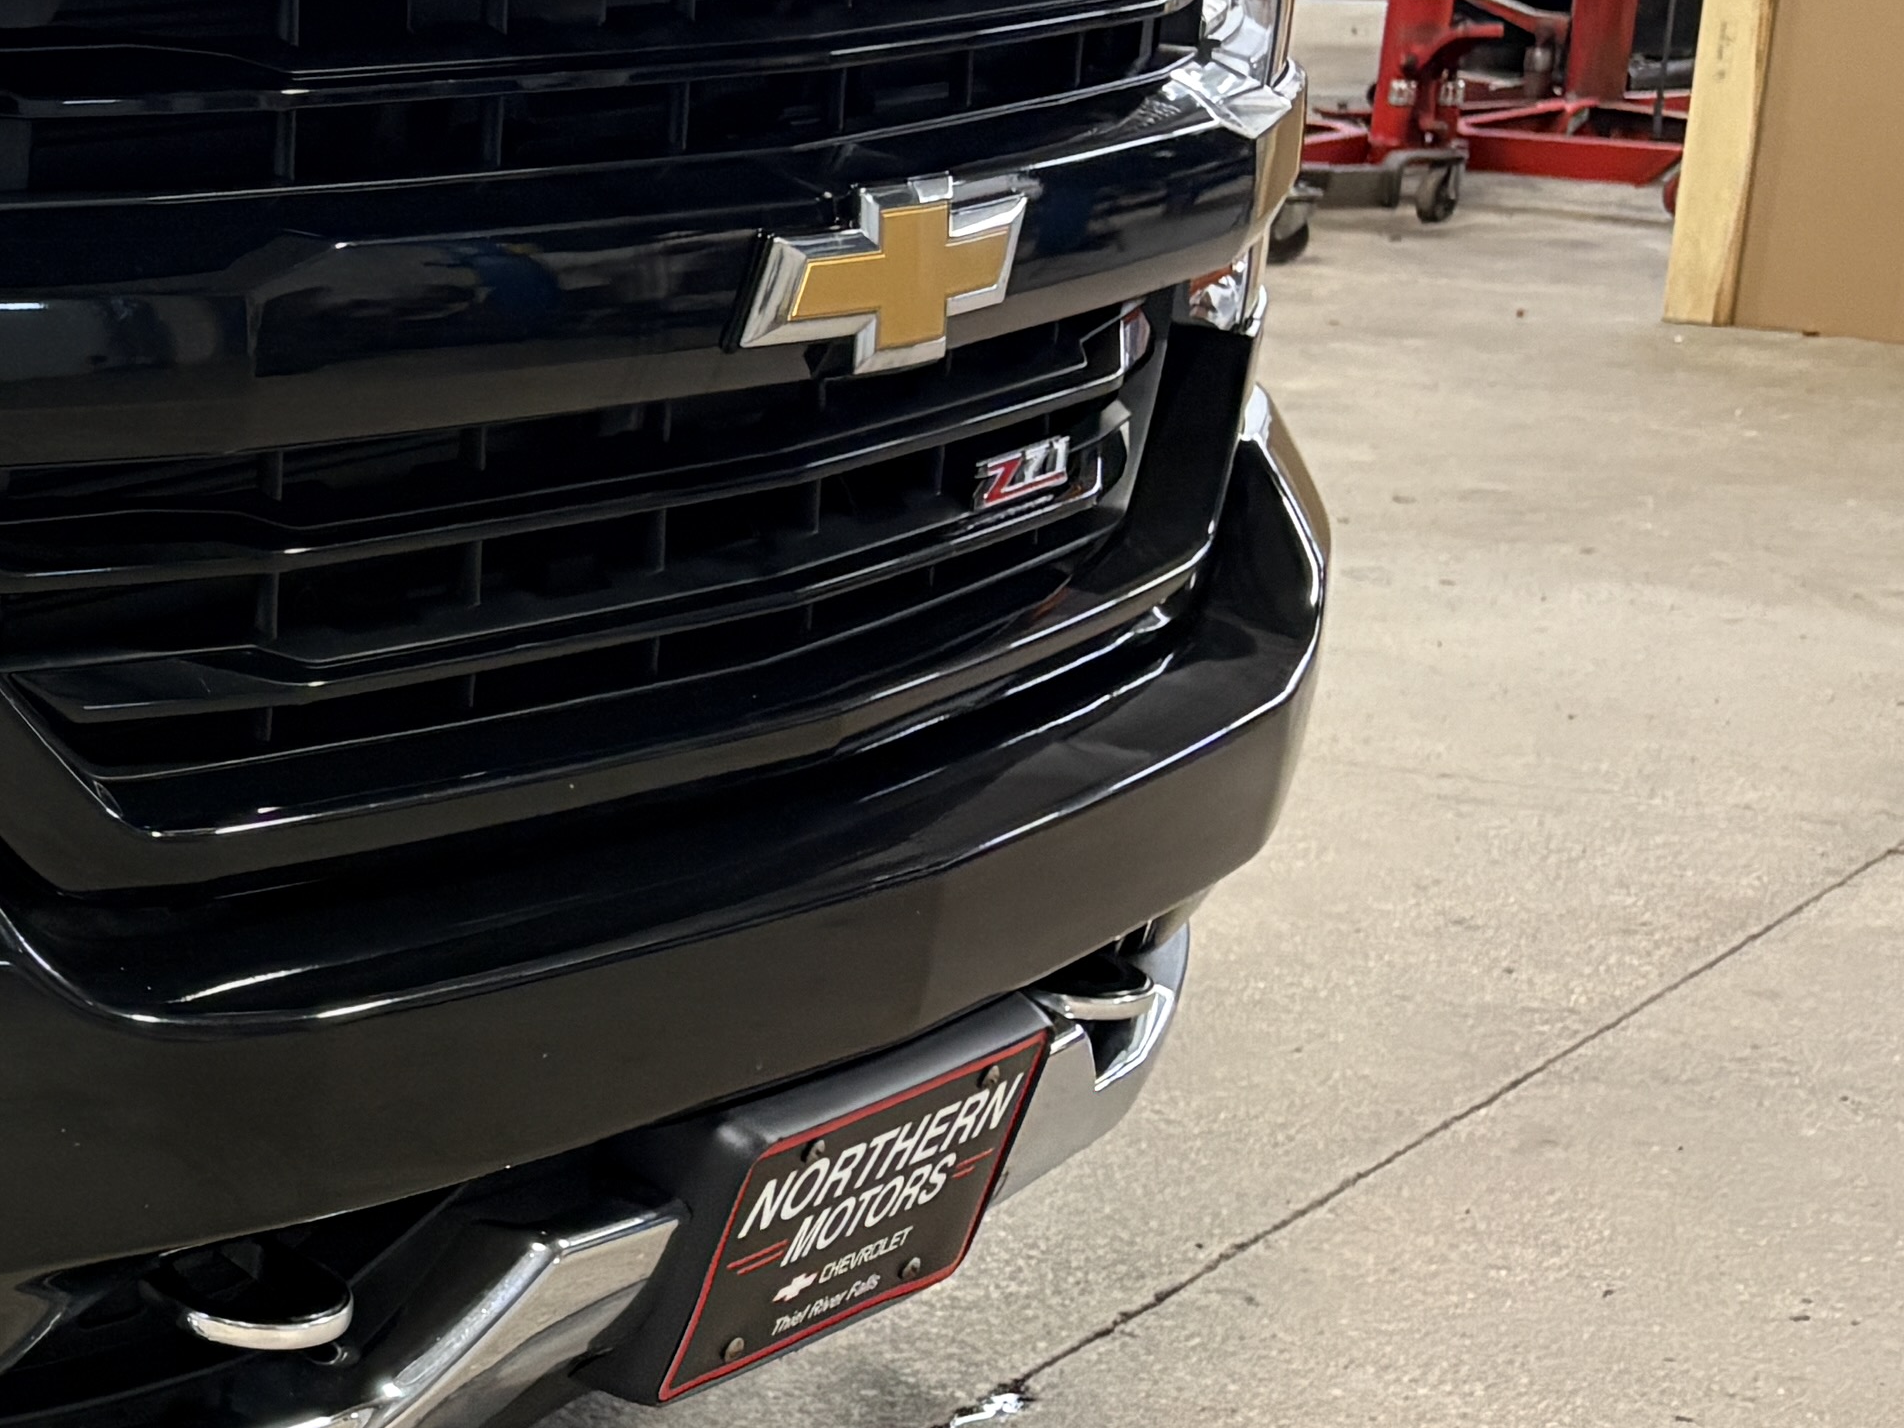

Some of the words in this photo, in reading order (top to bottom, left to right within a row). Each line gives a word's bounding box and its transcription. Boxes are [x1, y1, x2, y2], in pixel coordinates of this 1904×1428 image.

[975, 435, 1071, 508] Z71
[737, 1072, 1025, 1240] NORTHERN
[780, 1152, 957, 1268] MOTORS
[818, 1225, 914, 1284] CHEVROLET
[807, 1289, 848, 1320] River
[845, 1273, 882, 1301] Falls
